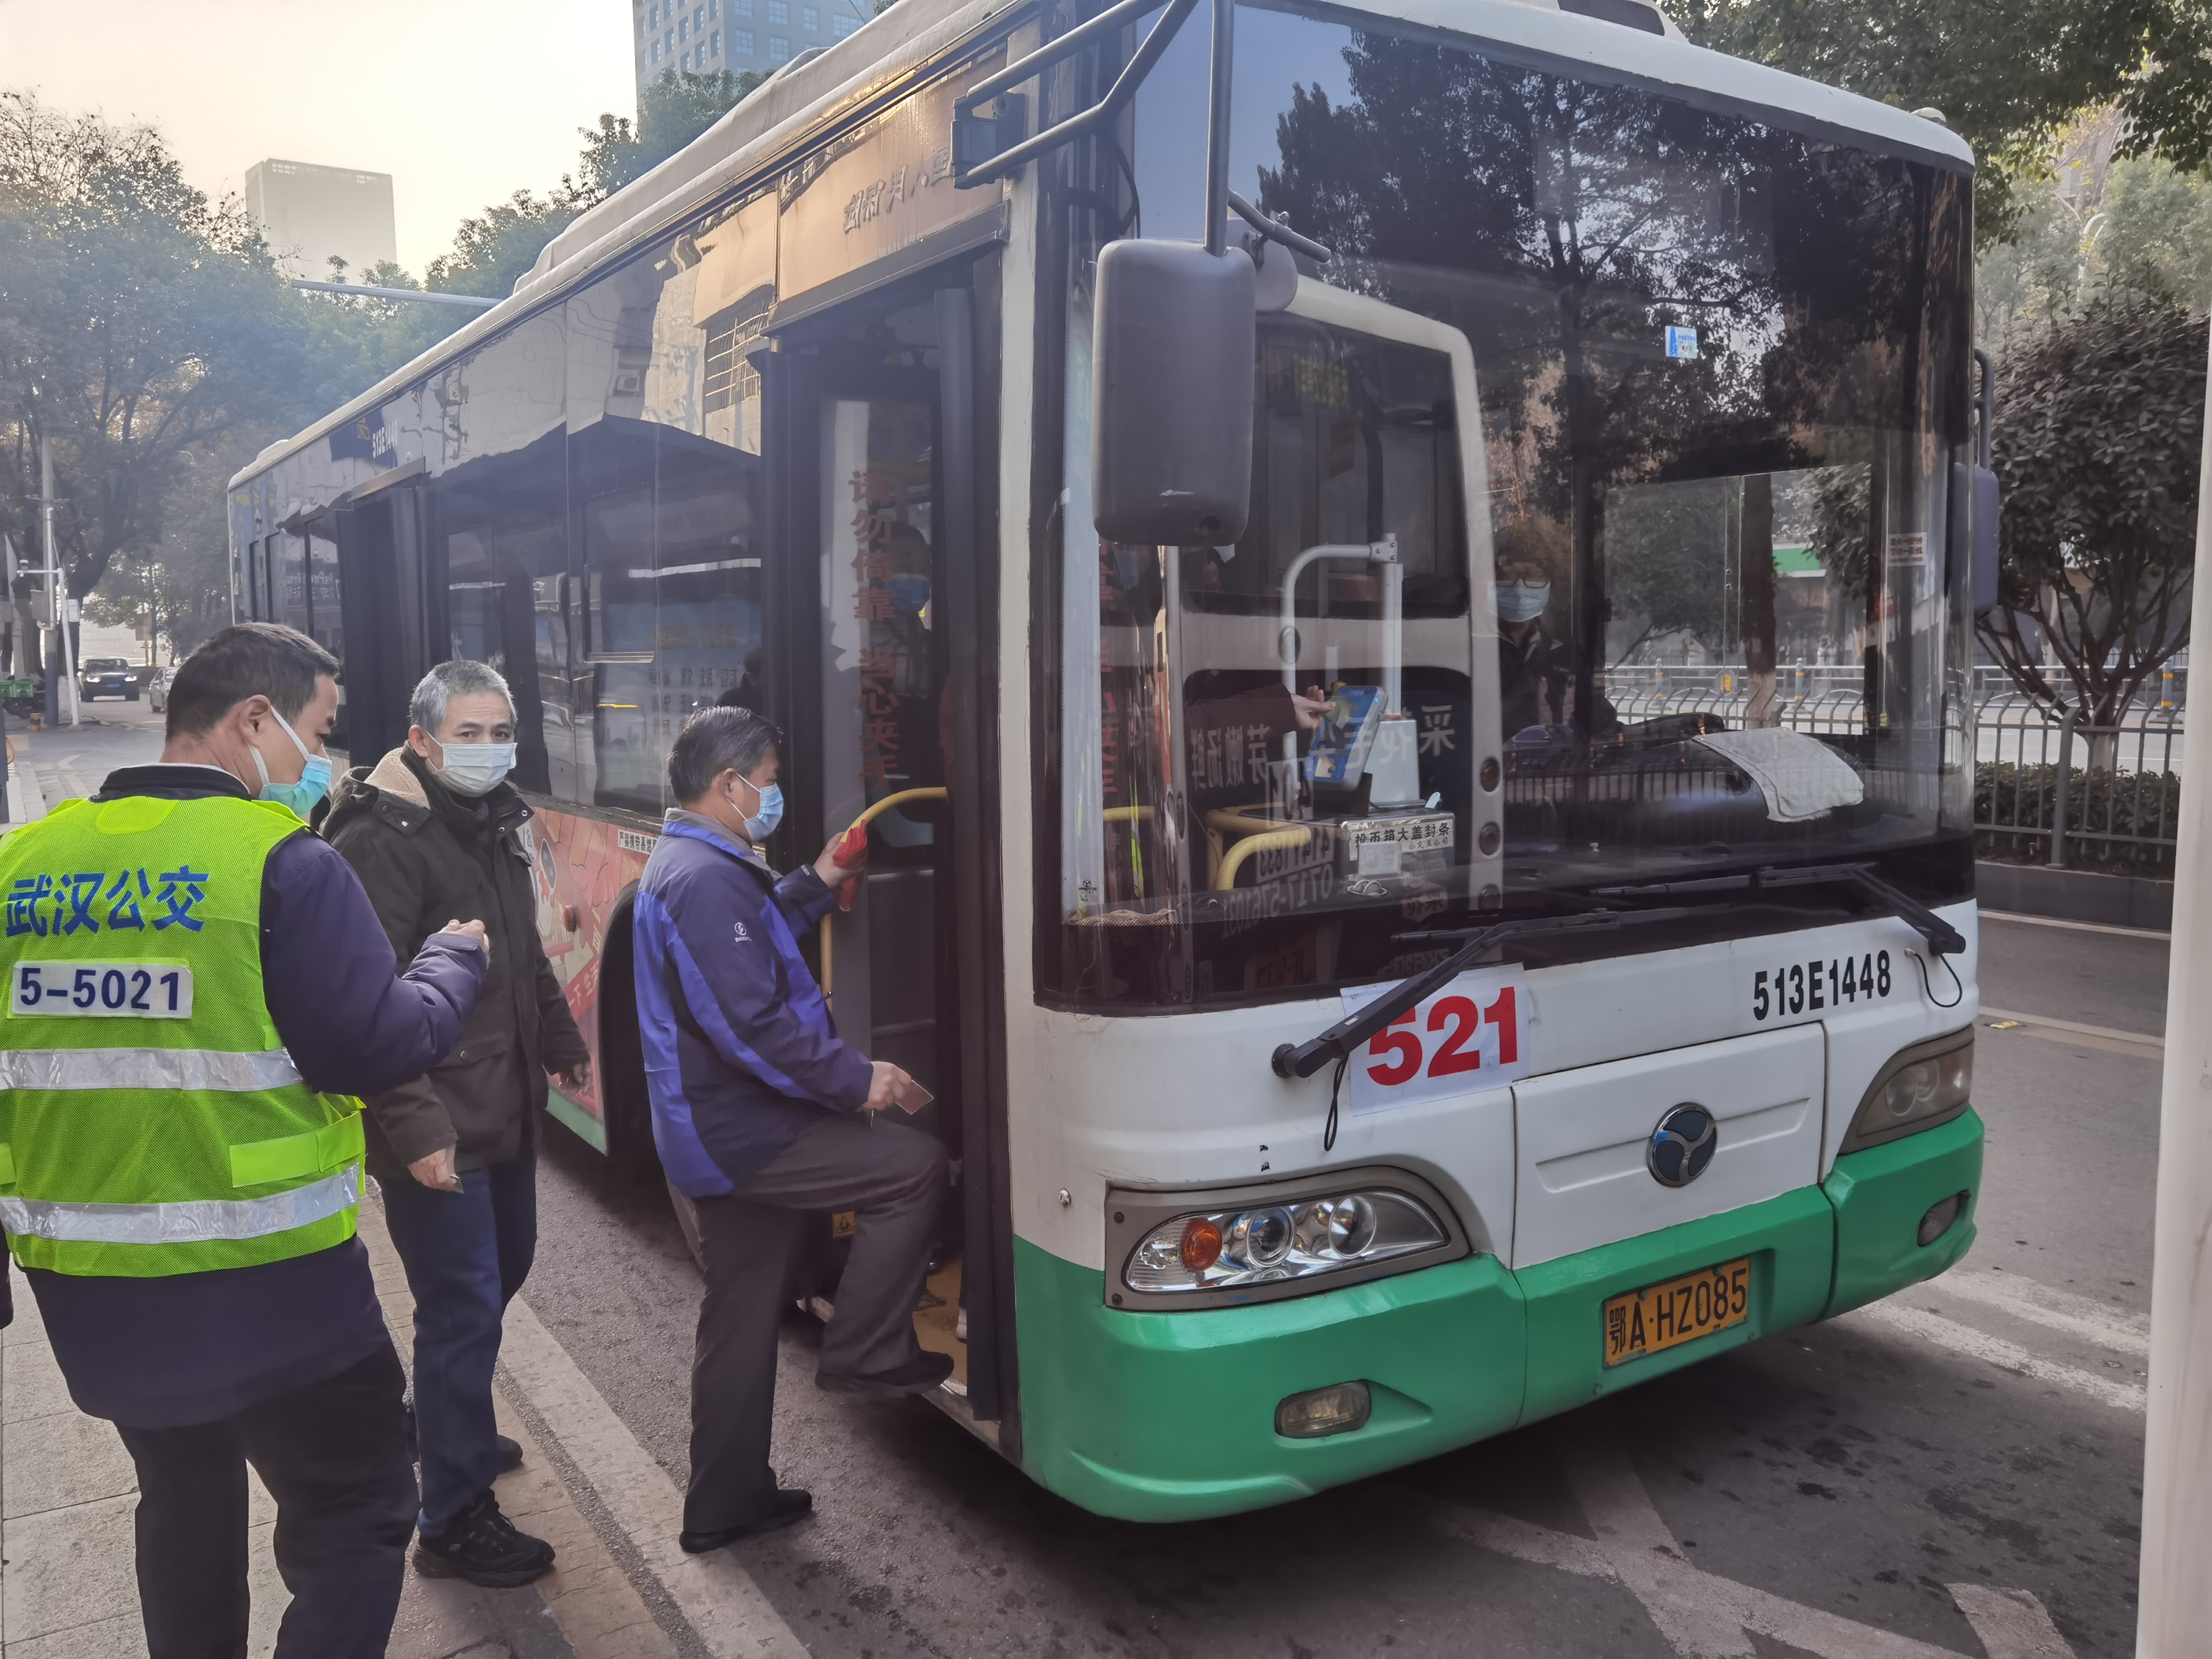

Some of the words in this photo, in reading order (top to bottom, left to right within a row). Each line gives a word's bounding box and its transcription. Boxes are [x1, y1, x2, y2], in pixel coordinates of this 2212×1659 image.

[373, 419, 398, 458] 513E1448
[849, 470, 896, 622] 请勿倚靠
[858, 646, 900, 789] 当心夹手
[1354, 822, 1450, 848] 投币箱大盖封条
[6, 865, 210, 938] 武汉公交
[21, 967, 179, 1010] 5-5021
[1753, 949, 1892, 1021] 513E1448
[1366, 986, 1518, 1086] 521
